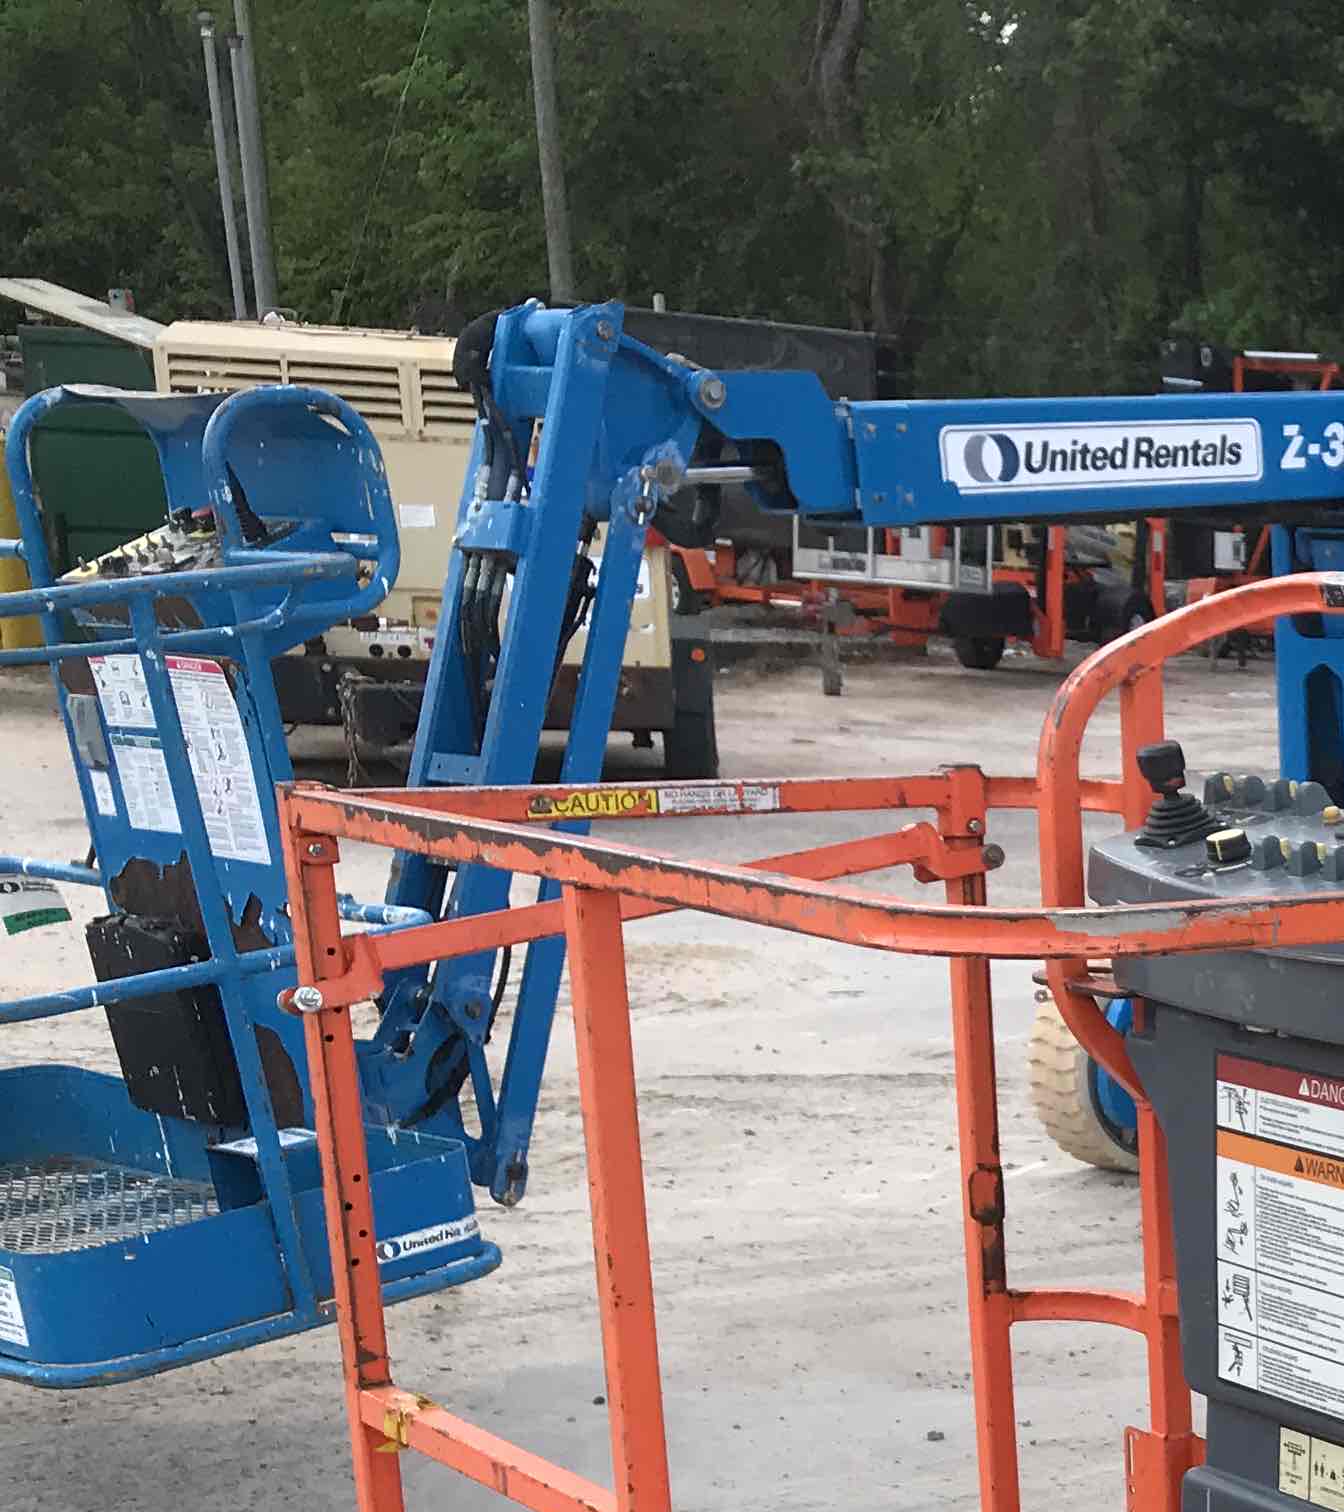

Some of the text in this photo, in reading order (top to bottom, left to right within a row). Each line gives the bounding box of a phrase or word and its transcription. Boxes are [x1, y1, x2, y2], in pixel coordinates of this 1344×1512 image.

[1024, 434, 1242, 474] United Rentals
[554, 790, 655, 812] CAUTION
